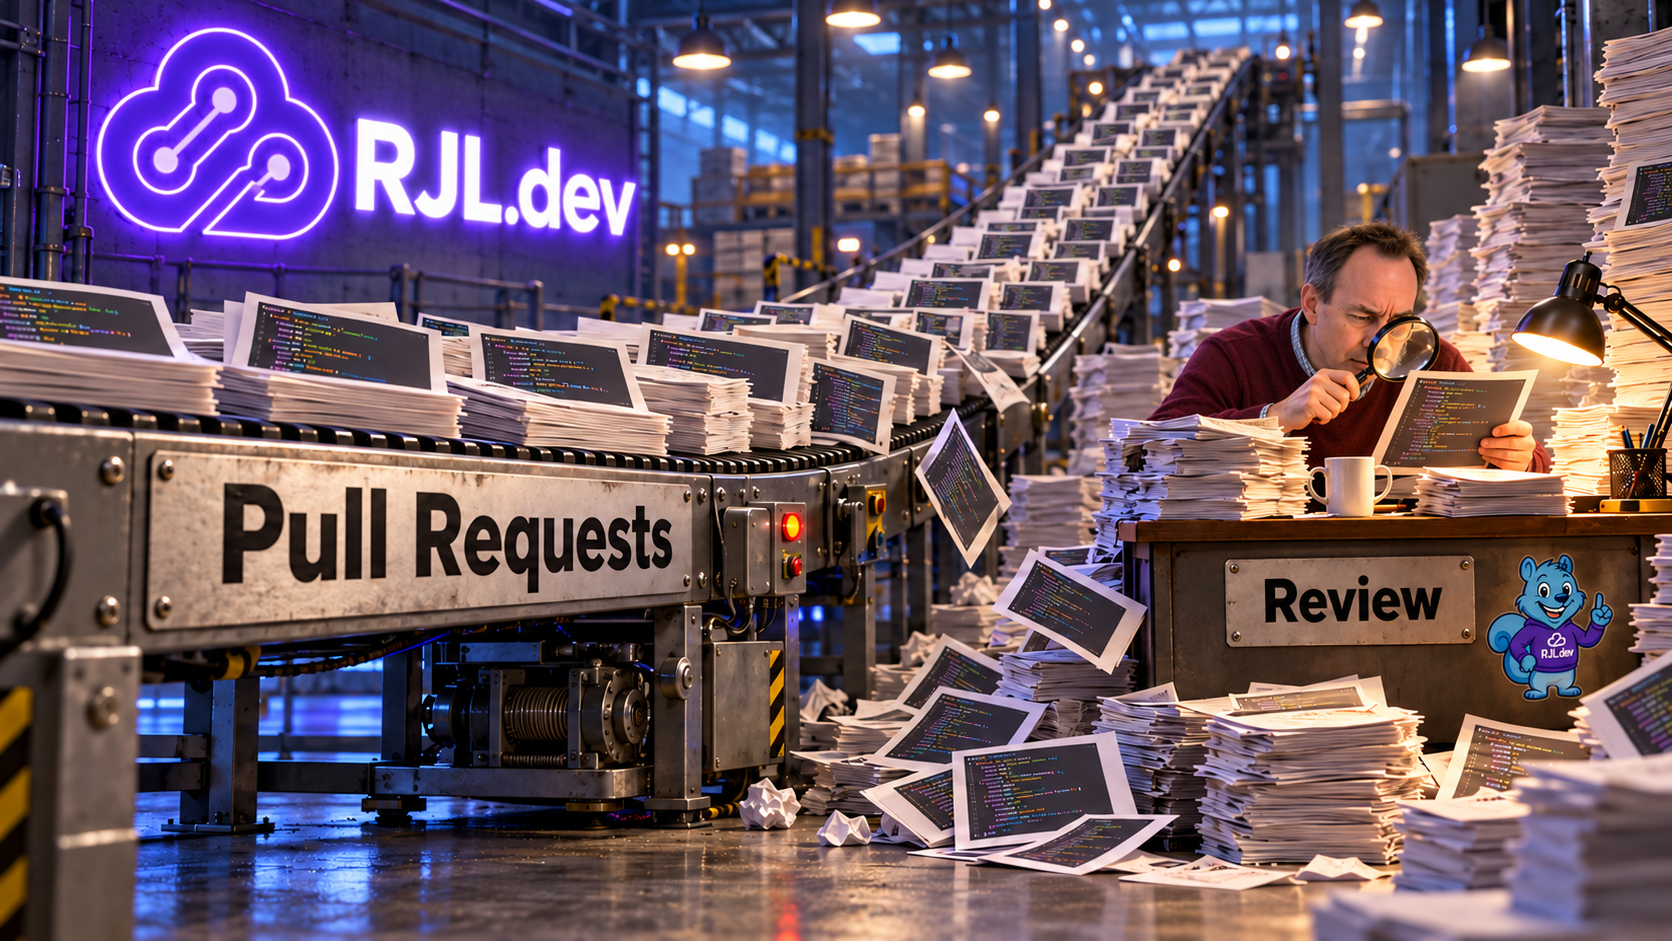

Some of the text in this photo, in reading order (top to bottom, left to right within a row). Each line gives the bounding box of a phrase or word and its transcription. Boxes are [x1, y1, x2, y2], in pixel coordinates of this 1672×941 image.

[355, 118, 636, 236] RJL.dev
[222, 482, 673, 593] Pull Requests
[1264, 575, 1443, 623] Review
